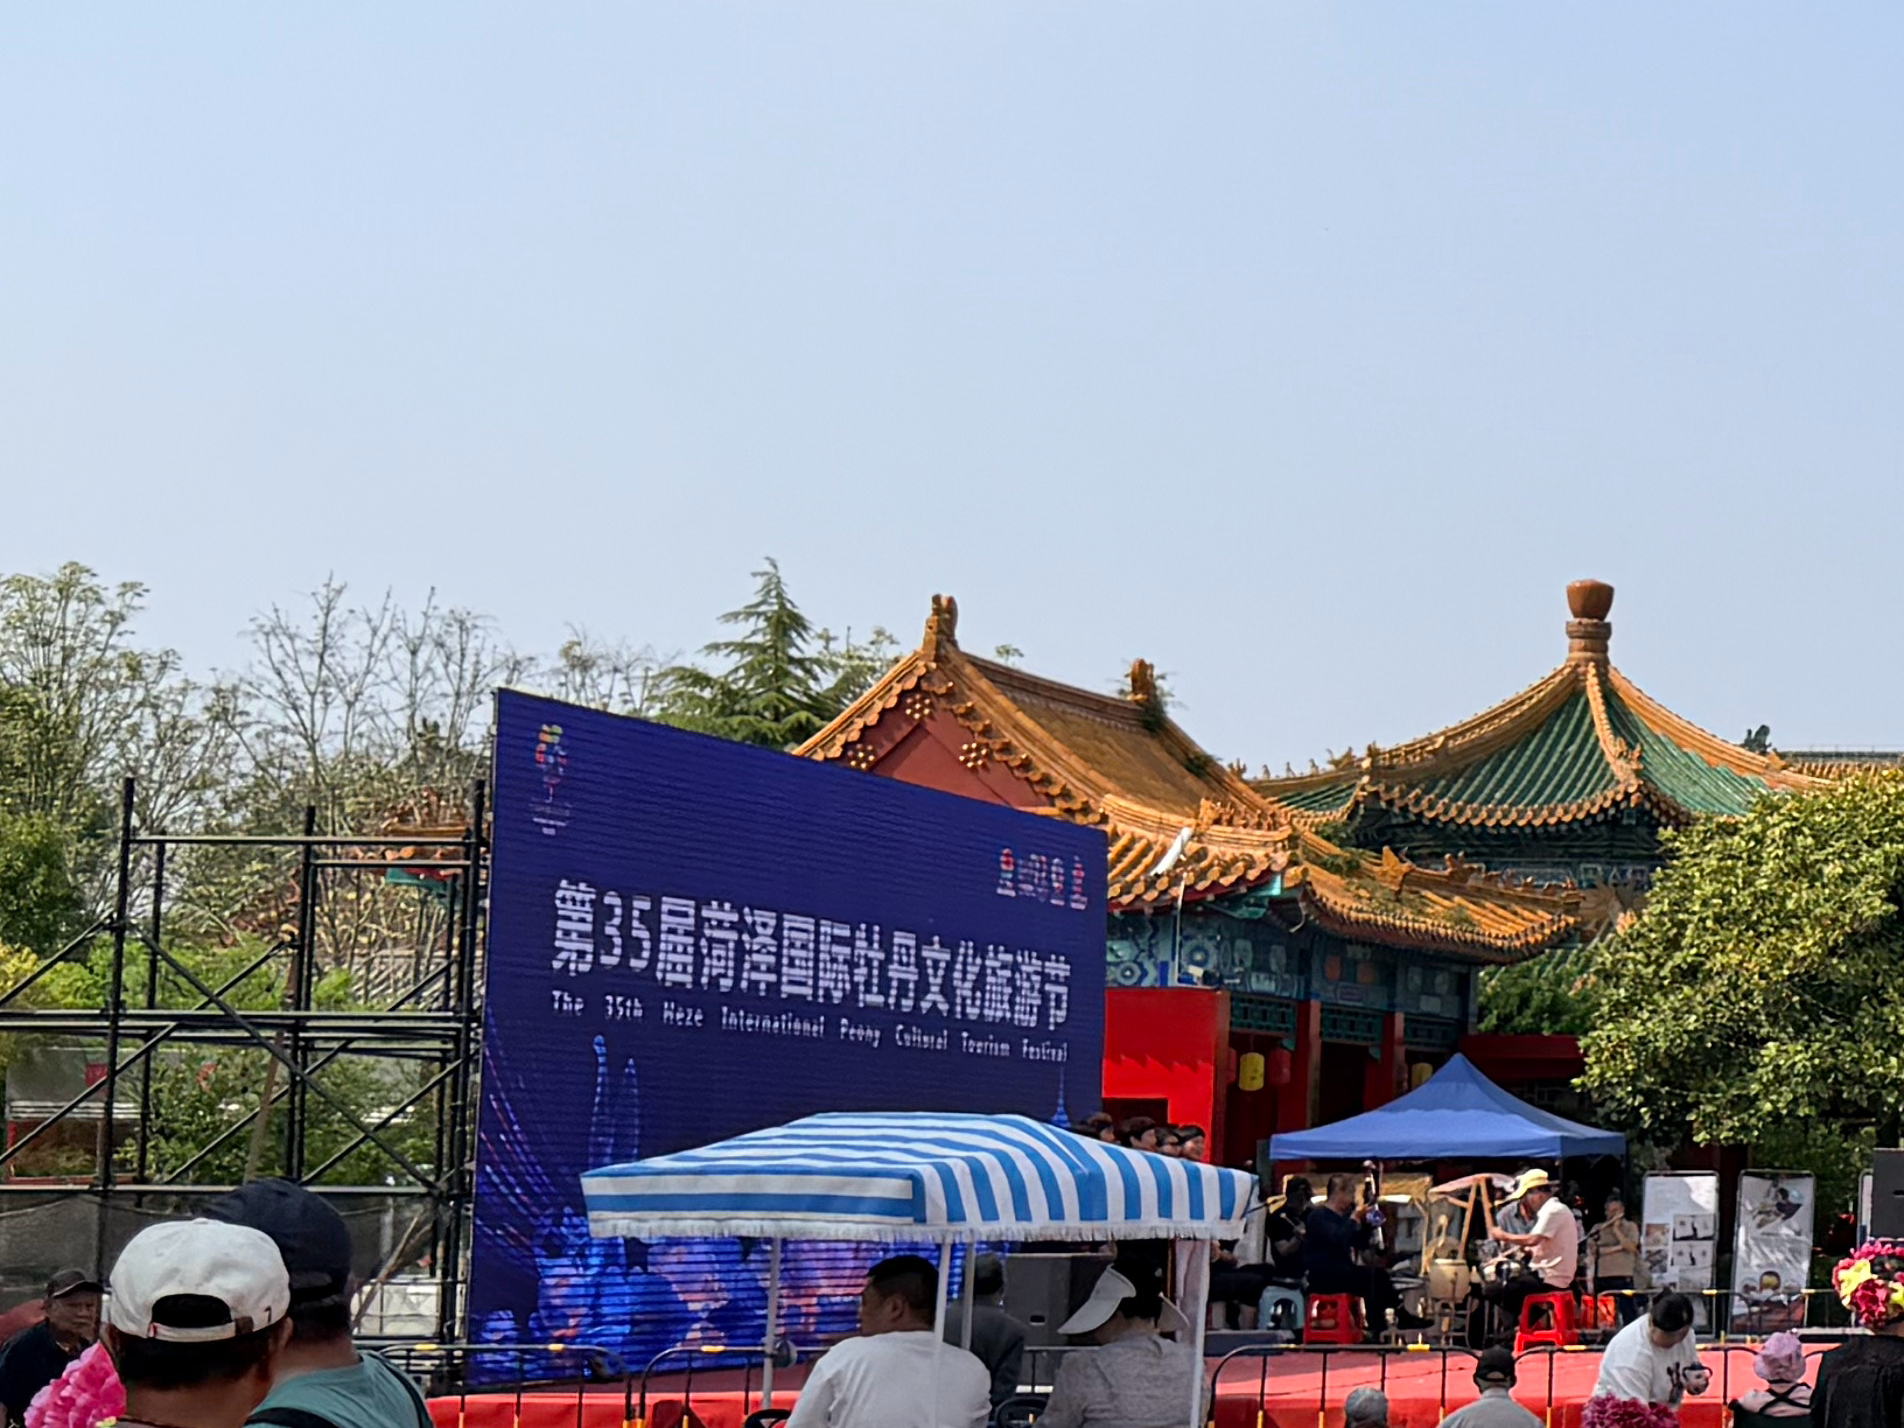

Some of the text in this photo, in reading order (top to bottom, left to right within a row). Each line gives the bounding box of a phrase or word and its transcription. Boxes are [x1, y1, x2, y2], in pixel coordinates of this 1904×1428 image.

[551, 878, 1071, 1030] 第35届菏泽国际牡丹文化旅游节
[552, 990, 584, 1016] The
[604, 994, 644, 1020] 35th
[663, 1000, 704, 1027] Heze
[721, 1005, 825, 1038] International
[840, 1017, 881, 1048] Peony
[961, 1030, 1010, 1056] Tourism
[1022, 1037, 1068, 1062] Festival
